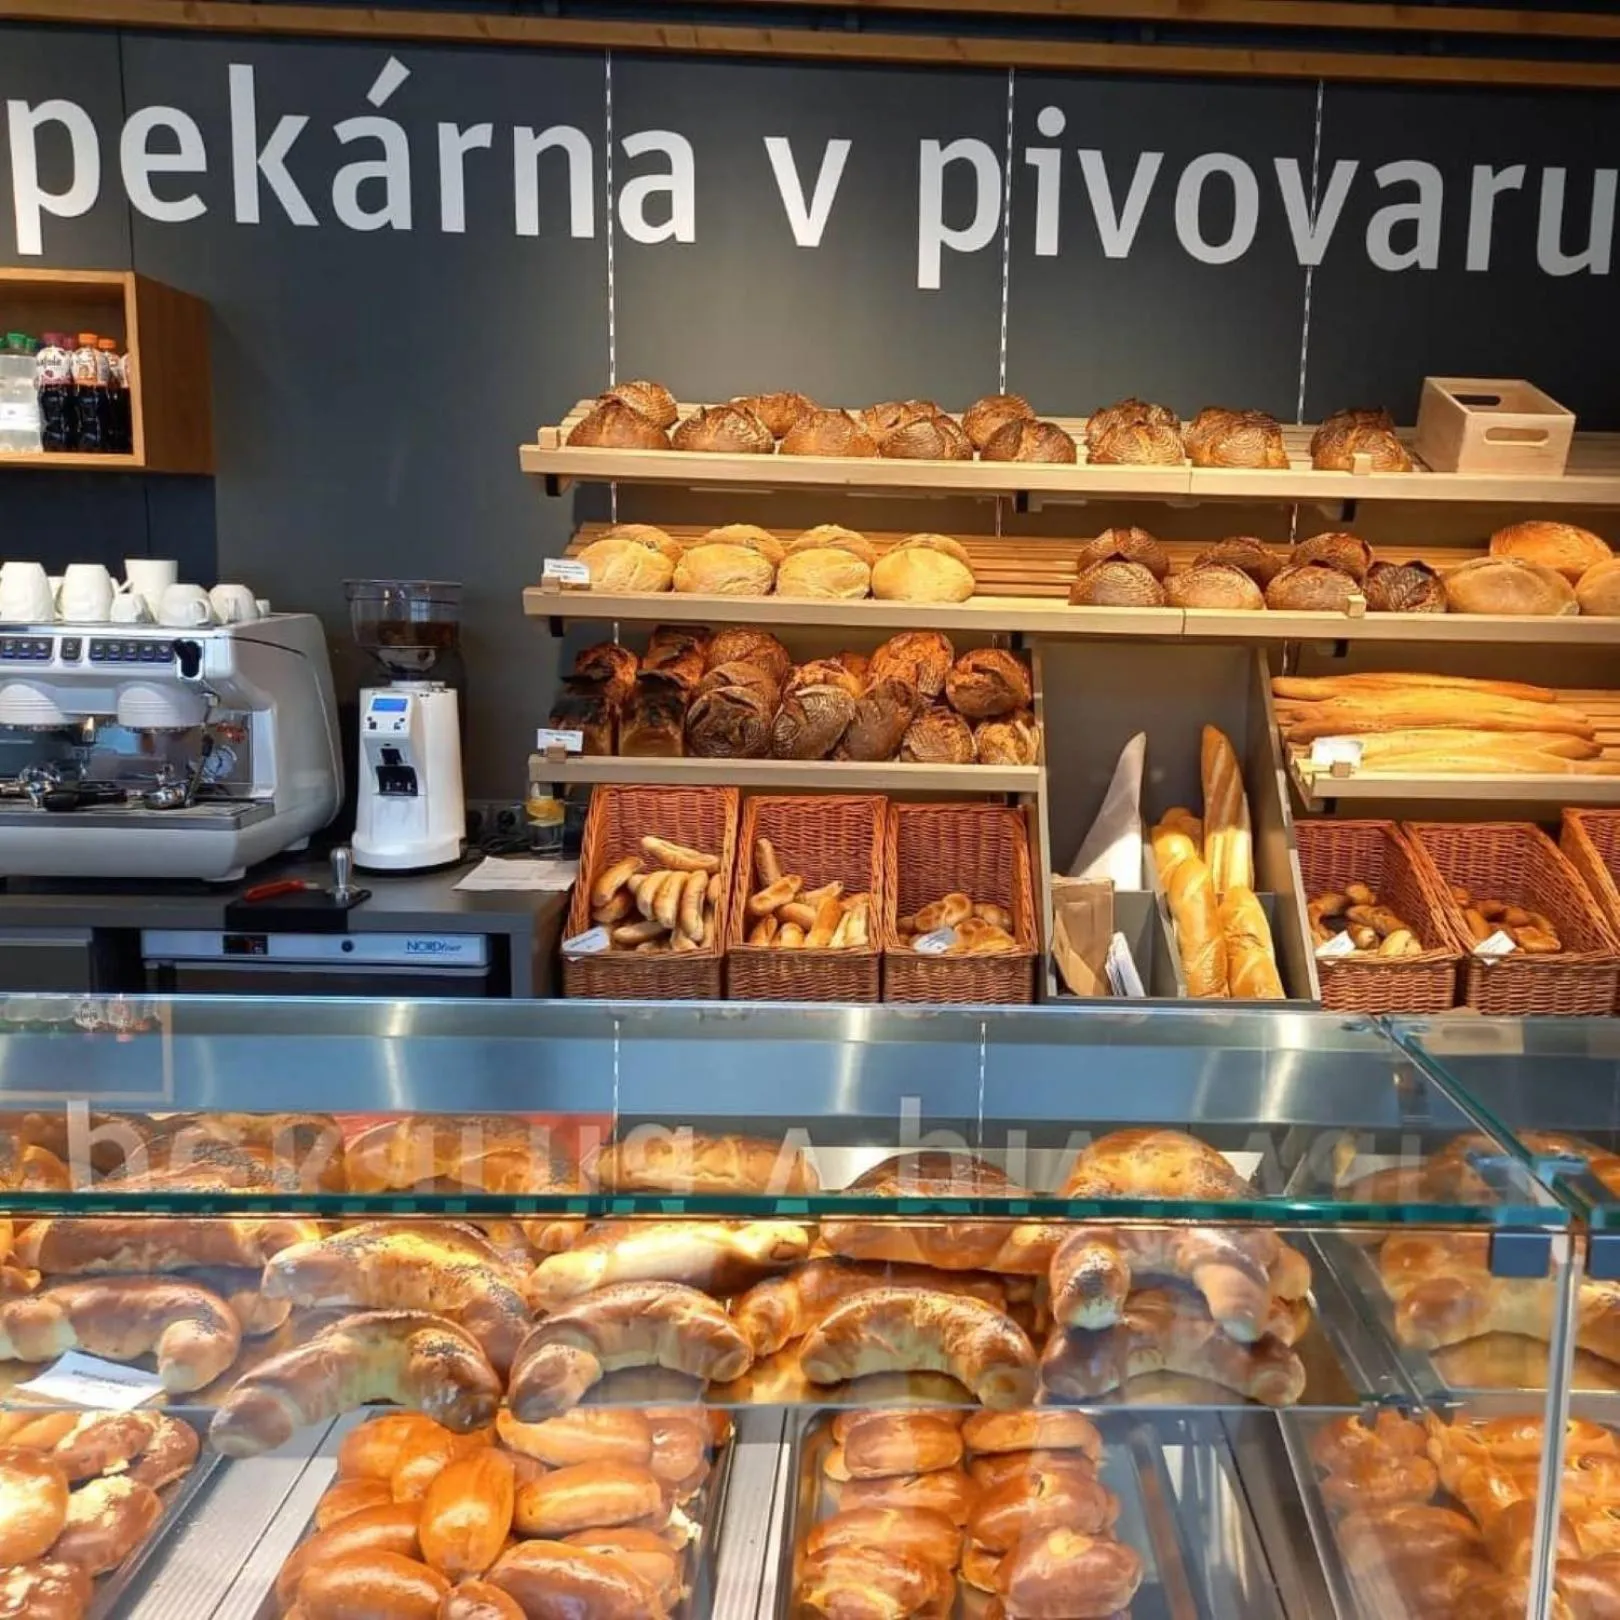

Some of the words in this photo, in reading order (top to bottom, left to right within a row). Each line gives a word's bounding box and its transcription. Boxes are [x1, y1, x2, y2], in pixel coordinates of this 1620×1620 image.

[7, 56, 697, 256] pekárna
[764, 136, 852, 248] v
[917, 106, 1618, 290] pivovaru
